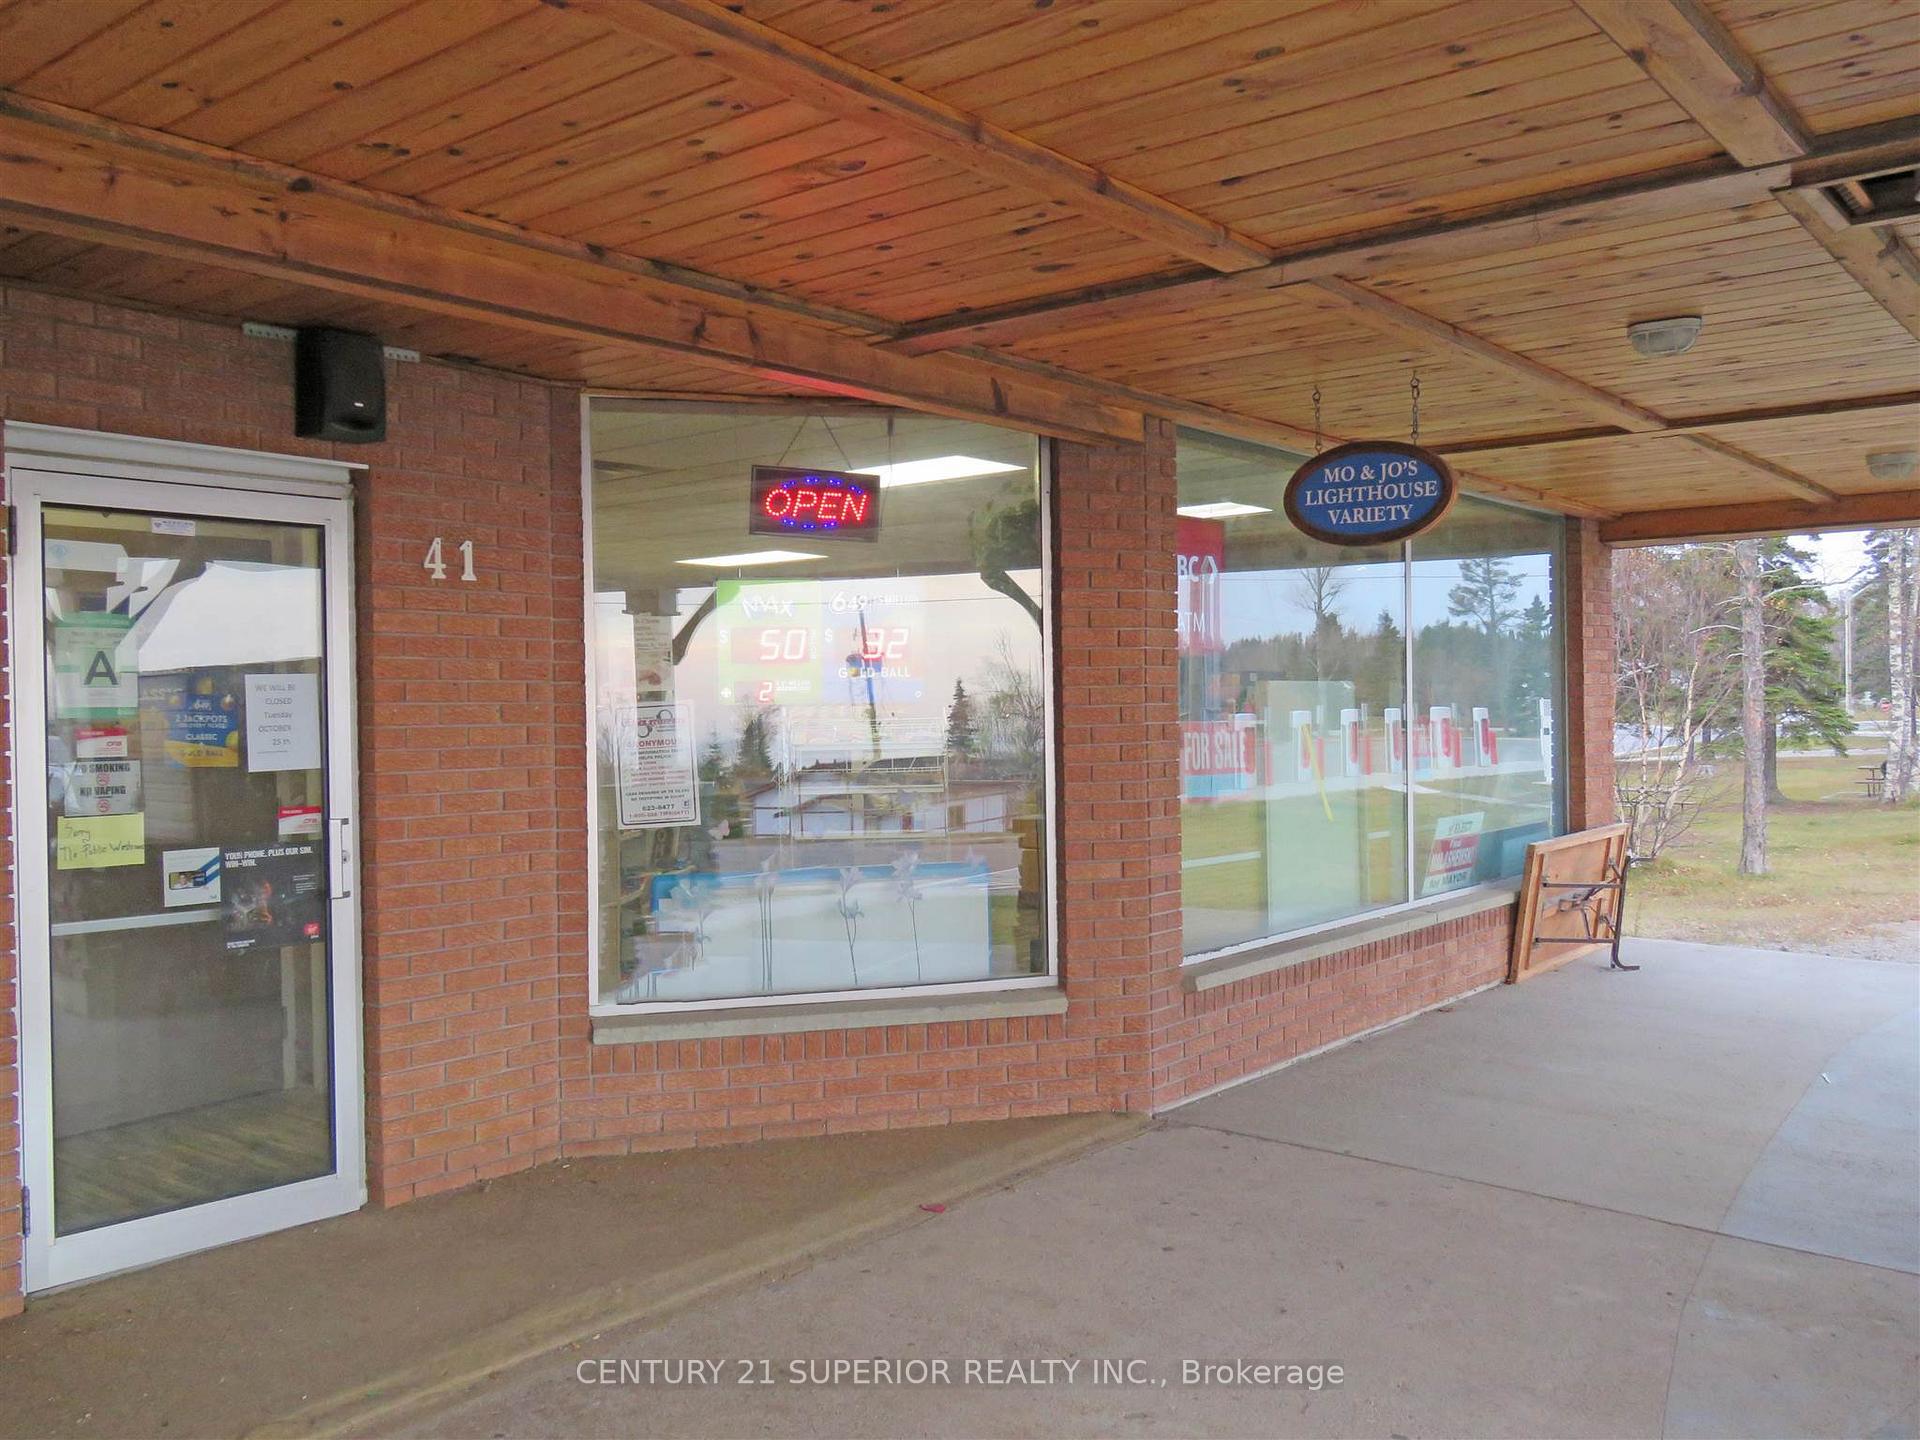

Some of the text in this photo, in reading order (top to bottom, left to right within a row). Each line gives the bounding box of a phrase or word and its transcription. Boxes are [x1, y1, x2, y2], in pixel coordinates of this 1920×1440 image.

[1324, 460, 1418, 484] MO & JO'S
[765, 488, 868, 521] OPEN
[1304, 481, 1438, 506] LIGHTHOUSE
[1328, 504, 1414, 525] VARIETY
[423, 537, 478, 581] 41
[1177, 554, 1200, 583] BC
[759, 628, 808, 661] 50
[83, 650, 119, 685] A
[881, 666, 911, 678] BALL
[265, 697, 293, 705] CLOSED
[759, 681, 773, 702] 2
[257, 725, 292, 733] OCTOBER
[1183, 731, 1247, 770] FOR SALE
[89, 762, 131, 773] SMOKING
[95, 785, 127, 796] VAPING
[224, 851, 242, 861] YOUR
[268, 848, 284, 857] PLUS
[285, 847, 299, 855] OUR
